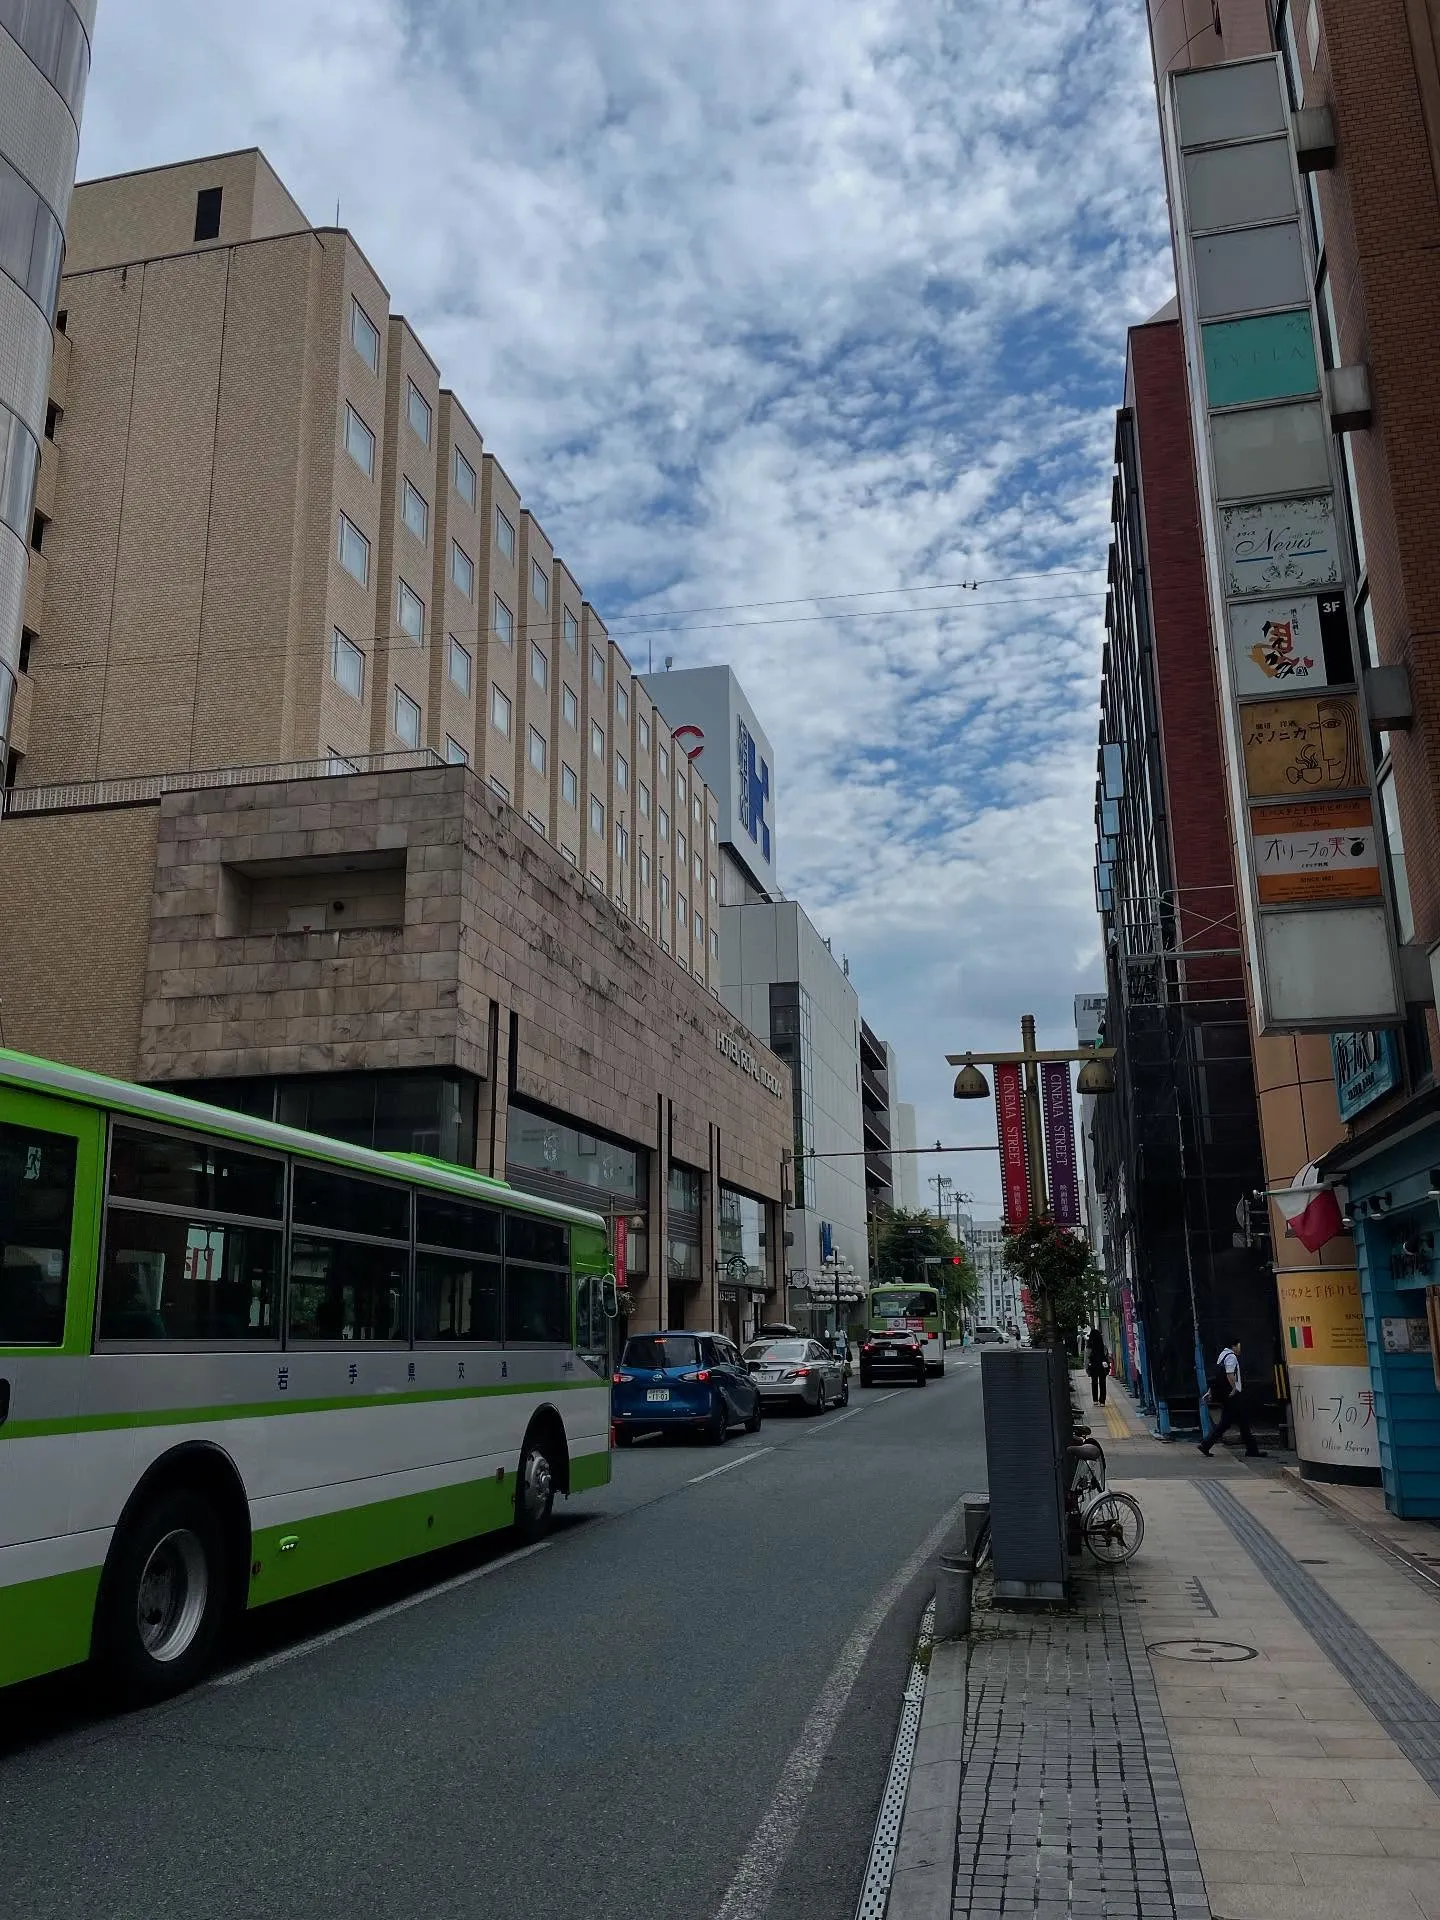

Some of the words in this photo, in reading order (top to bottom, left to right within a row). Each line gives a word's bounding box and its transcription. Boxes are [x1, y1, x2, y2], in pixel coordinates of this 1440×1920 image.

[1235, 527, 1312, 556] Nevis
[1322, 601, 1340, 613] 3F
[1247, 727, 1307, 745] パノニカ
[716, 1029, 740, 1065] HOTEL
[1003, 1075, 1017, 1119] CINEMA
[1050, 1074, 1064, 1118] CINEMA
[1007, 1126, 1021, 1166] STREET
[1054, 1125, 1068, 1165] STREET
[1321, 1437, 1341, 1450] Olive
[1345, 1440, 1370, 1456] Berry
